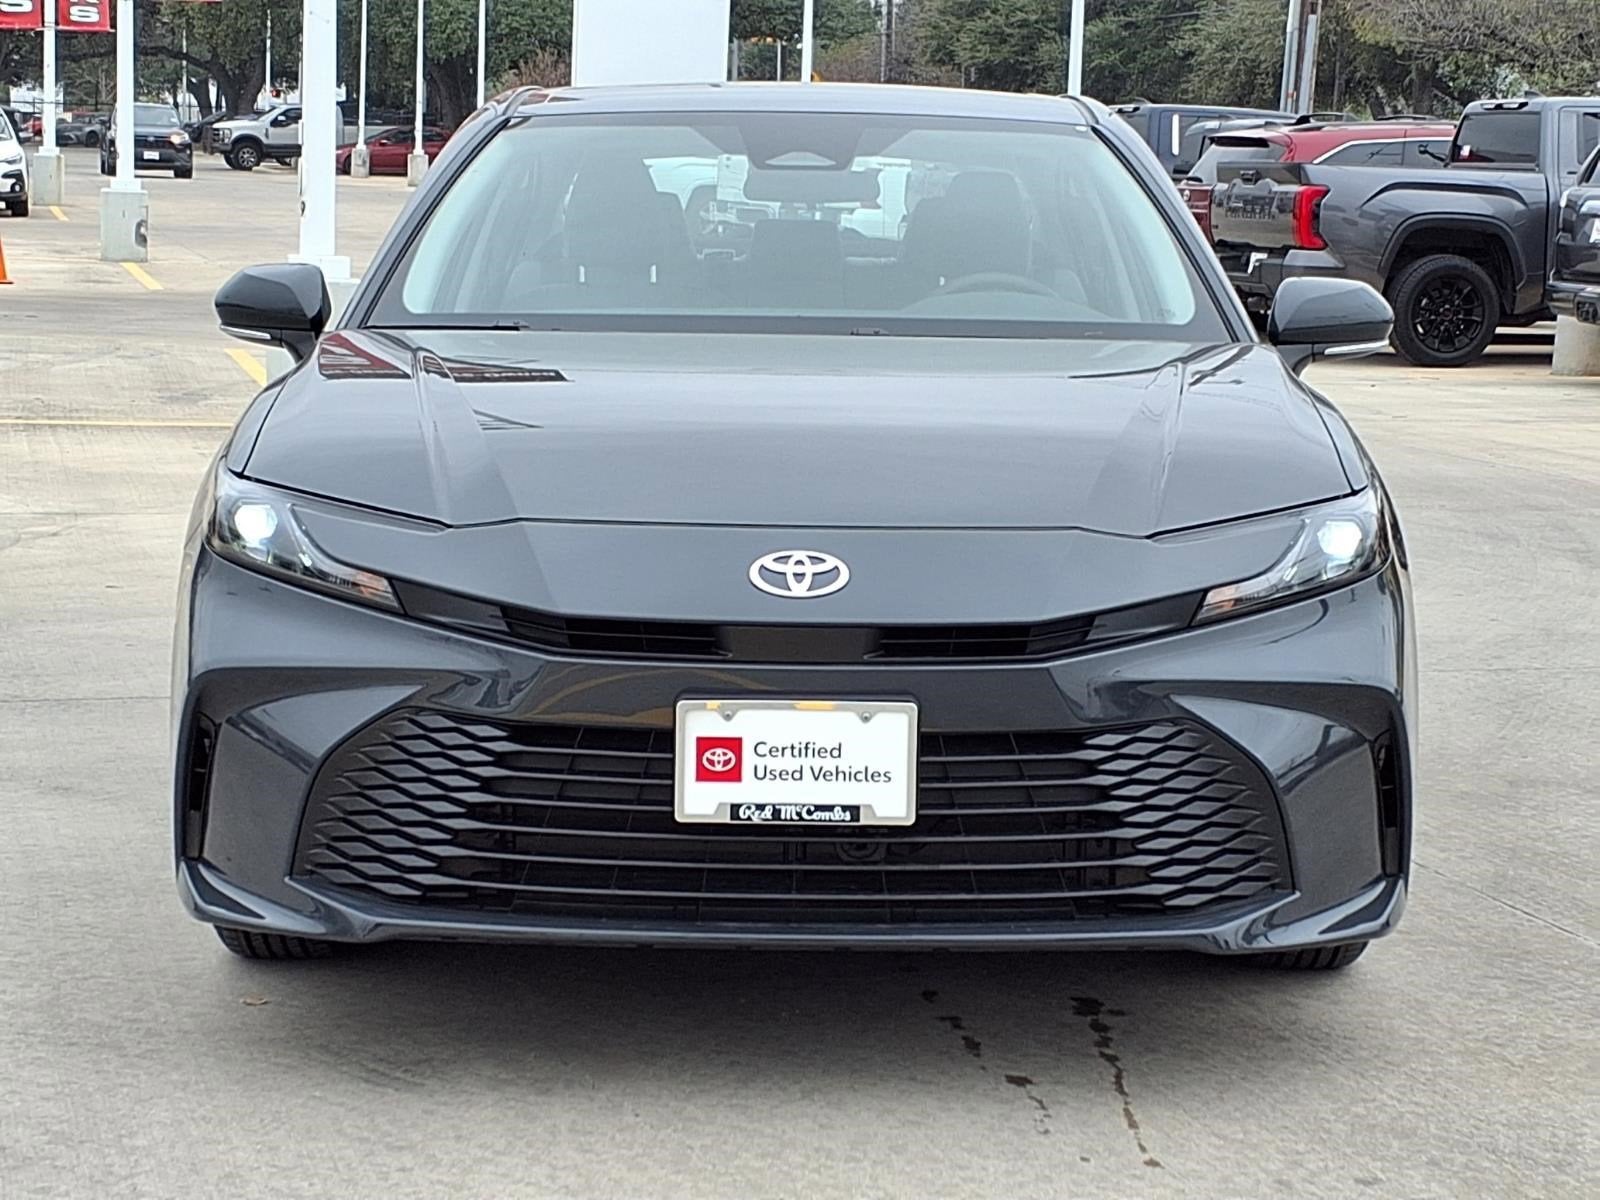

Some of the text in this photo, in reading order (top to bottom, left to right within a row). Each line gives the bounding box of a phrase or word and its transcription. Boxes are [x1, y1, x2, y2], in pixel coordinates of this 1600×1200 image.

[753, 741, 842, 759] Certified
[753, 764, 892, 783] Used Vehicles
[738, 804, 773, 821] Red
